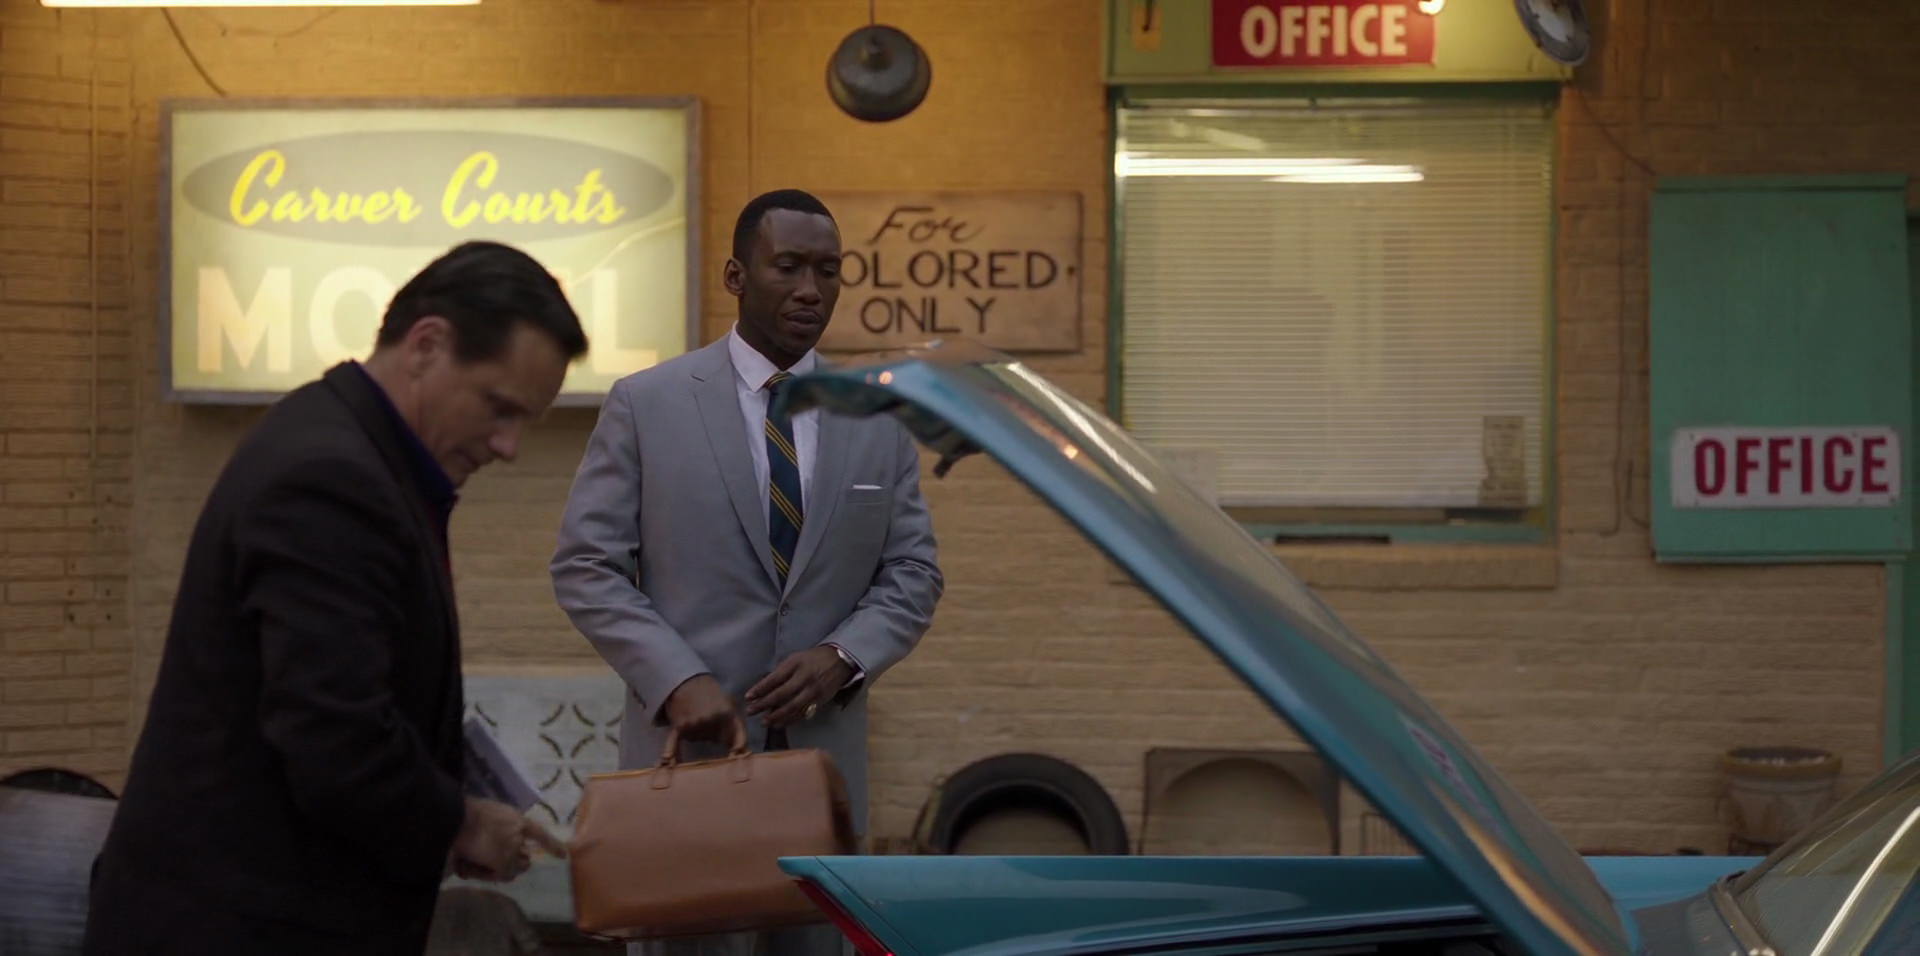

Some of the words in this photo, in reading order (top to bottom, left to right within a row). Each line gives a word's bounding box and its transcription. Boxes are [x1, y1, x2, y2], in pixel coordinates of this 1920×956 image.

[1240, 5, 1407, 58] OFFICE
[230, 150, 421, 226] Carver
[441, 151, 624, 228] Courts
[866, 205, 986, 245] For
[840, 251, 1057, 289] OLORED
[197, 267, 658, 373] MOL
[860, 297, 995, 334] ONLY
[1694, 436, 1889, 496] OFFICE
